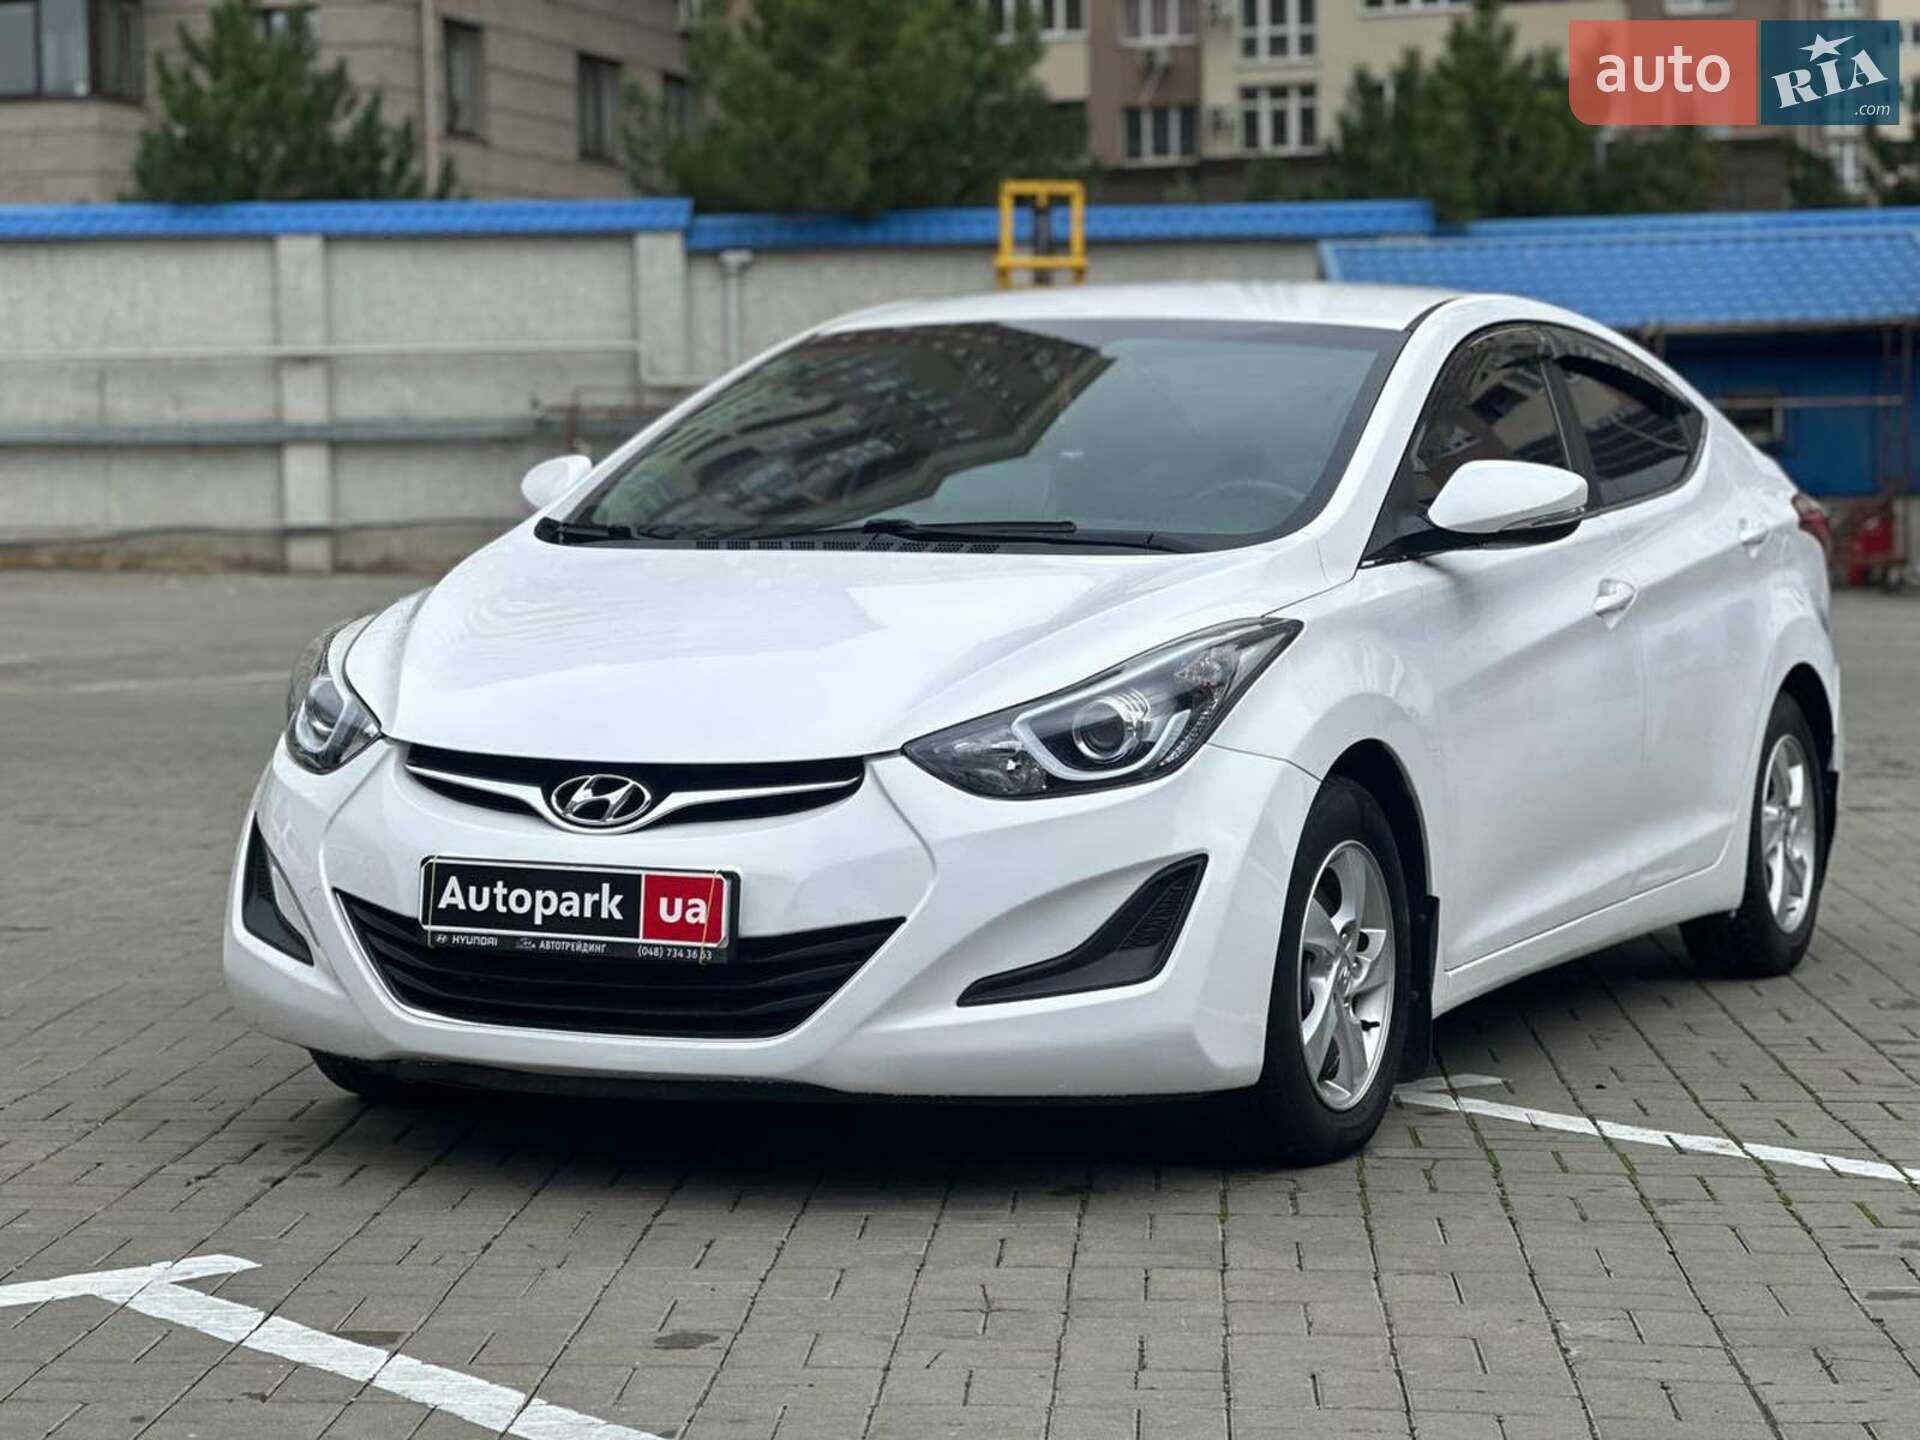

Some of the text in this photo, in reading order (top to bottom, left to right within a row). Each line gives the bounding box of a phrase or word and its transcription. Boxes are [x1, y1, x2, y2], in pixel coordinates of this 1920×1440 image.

[437, 875, 708, 925] Autopark ua
[452, 935, 498, 946] HYUNDAI
[539, 940, 607, 954] АВТОТРЕЙДИНГ
[637, 945, 664, 958] (048)
[666, 948, 684, 958] 734
